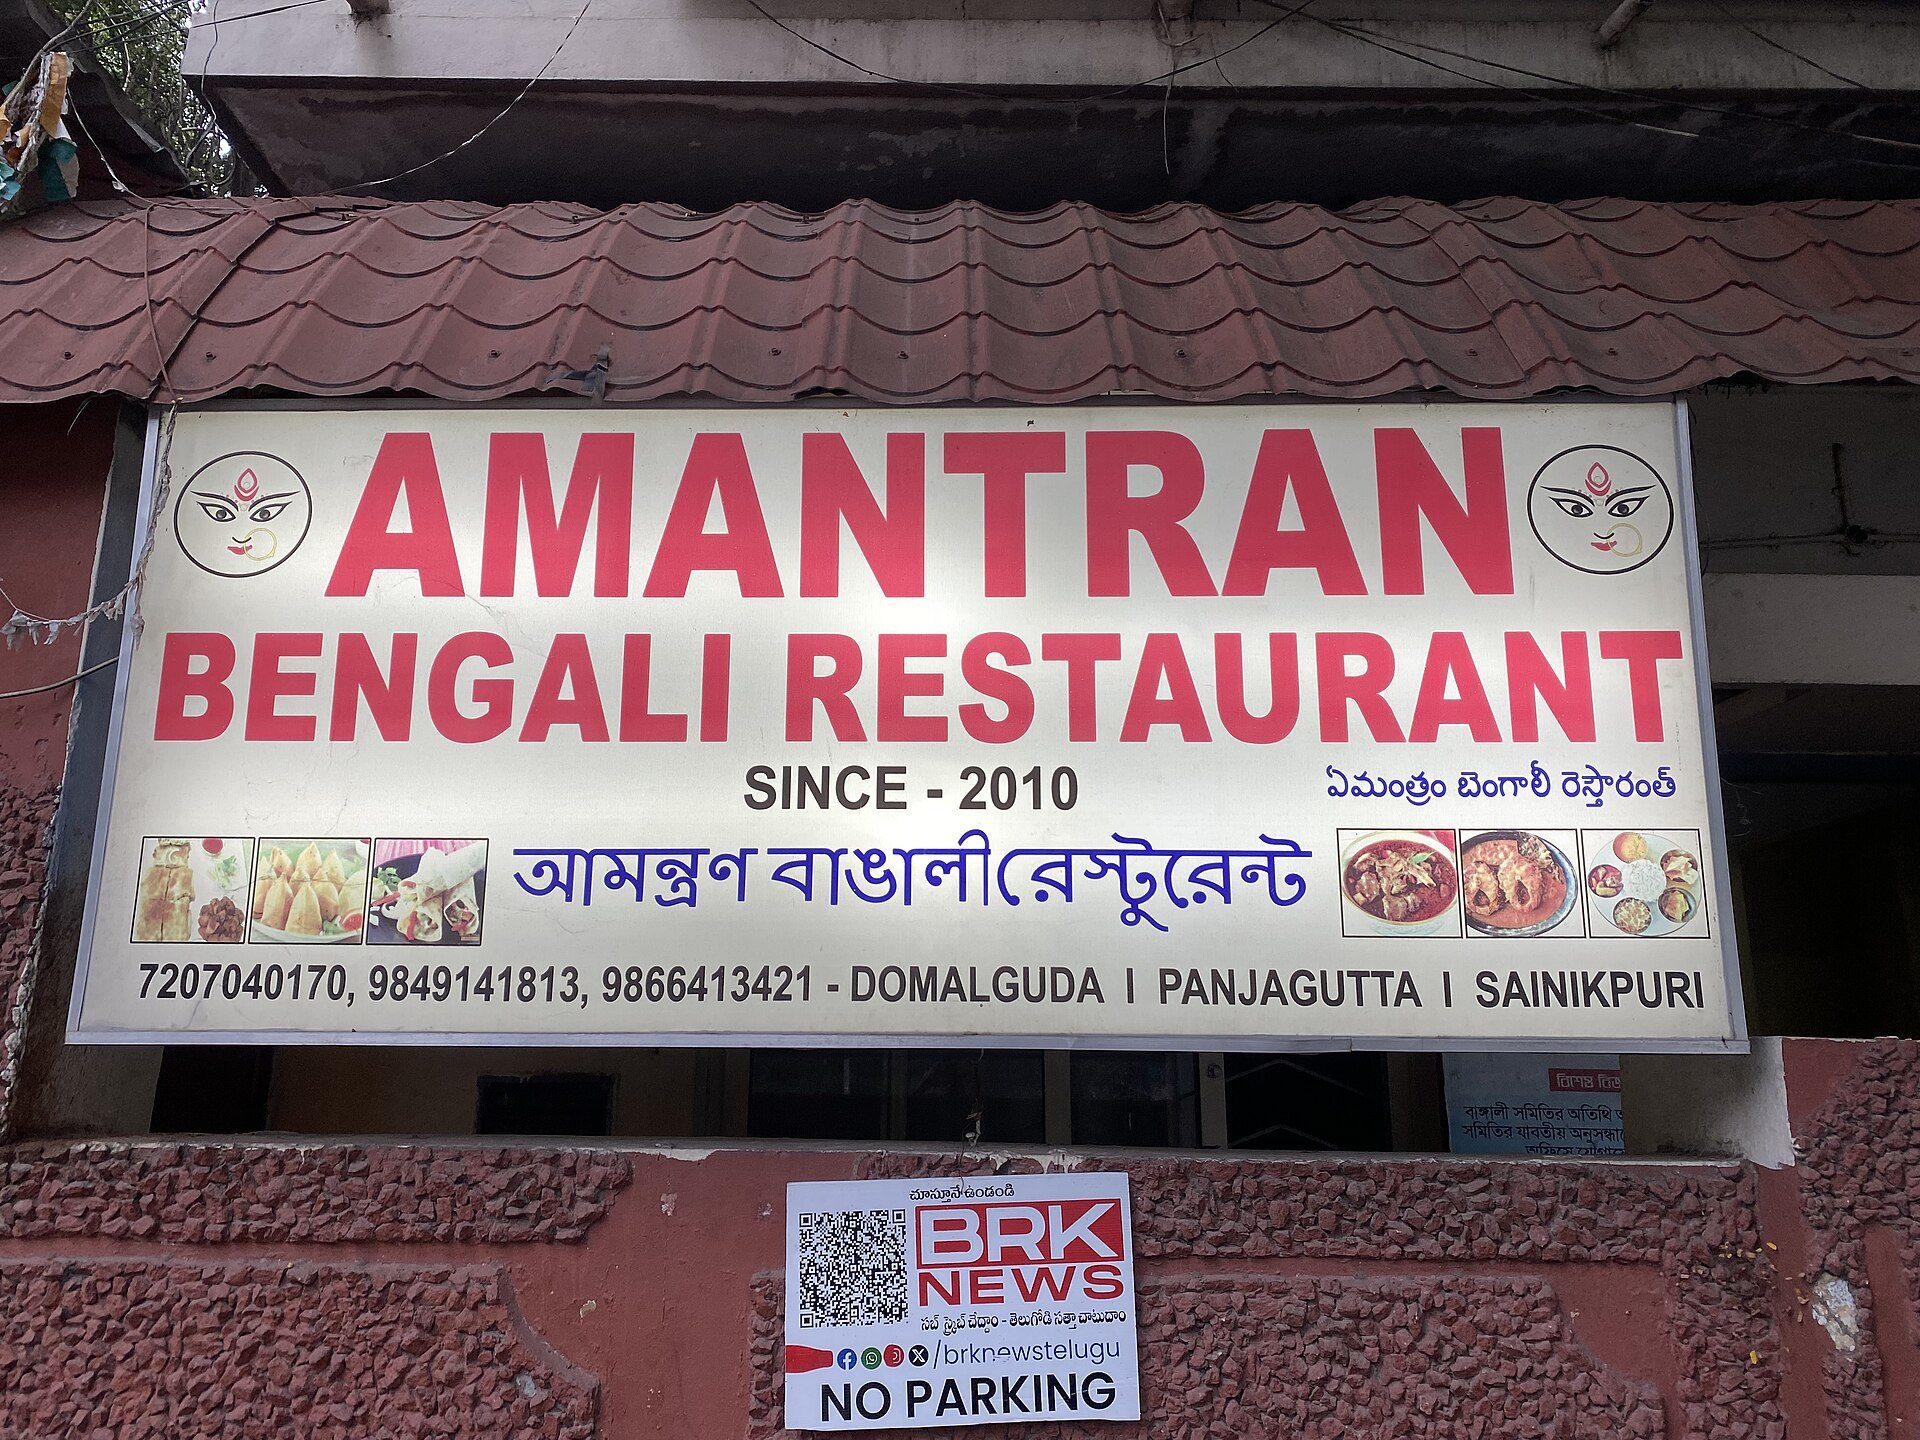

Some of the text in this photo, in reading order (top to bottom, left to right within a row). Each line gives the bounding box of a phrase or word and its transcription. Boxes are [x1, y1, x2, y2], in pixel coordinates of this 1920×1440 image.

[326, 428, 1513, 598] AMANTRAN
[155, 631, 1682, 743] BENGALI RESTAURANT
[744, 766, 1077, 810] SINCE - 2010
[1327, 765, 1446, 806] ఏమంత్రం
[1458, 760, 1550, 797] బెంగాలీ
[514, 830, 1312, 932] আমন্ত্রণ বাঙালী রেস্টুরেন্ট
[140, 963, 354, 1007] 7207040170,
[369, 965, 587, 1009] 9849141813,
[603, 965, 809, 1002] 9866413421
[828, 984, 839, 993] -
[852, 966, 1104, 1007] DOMALGUDA
[1160, 968, 1422, 1008] PANJAGUTTA
[1476, 970, 1704, 1009] SAINIKPURI
[1462, 1121, 1512, 1139] সমিতির
[1464, 1102, 1509, 1120] বাঙ্গালী
[1513, 1103, 1564, 1121] সমিতির
[1568, 1104, 1612, 1122] অতিথি
[920, 1203, 1118, 1264] BRK
[919, 1265, 1123, 1306] NEWS
[821, 1372, 1116, 1422] NO PARKING
